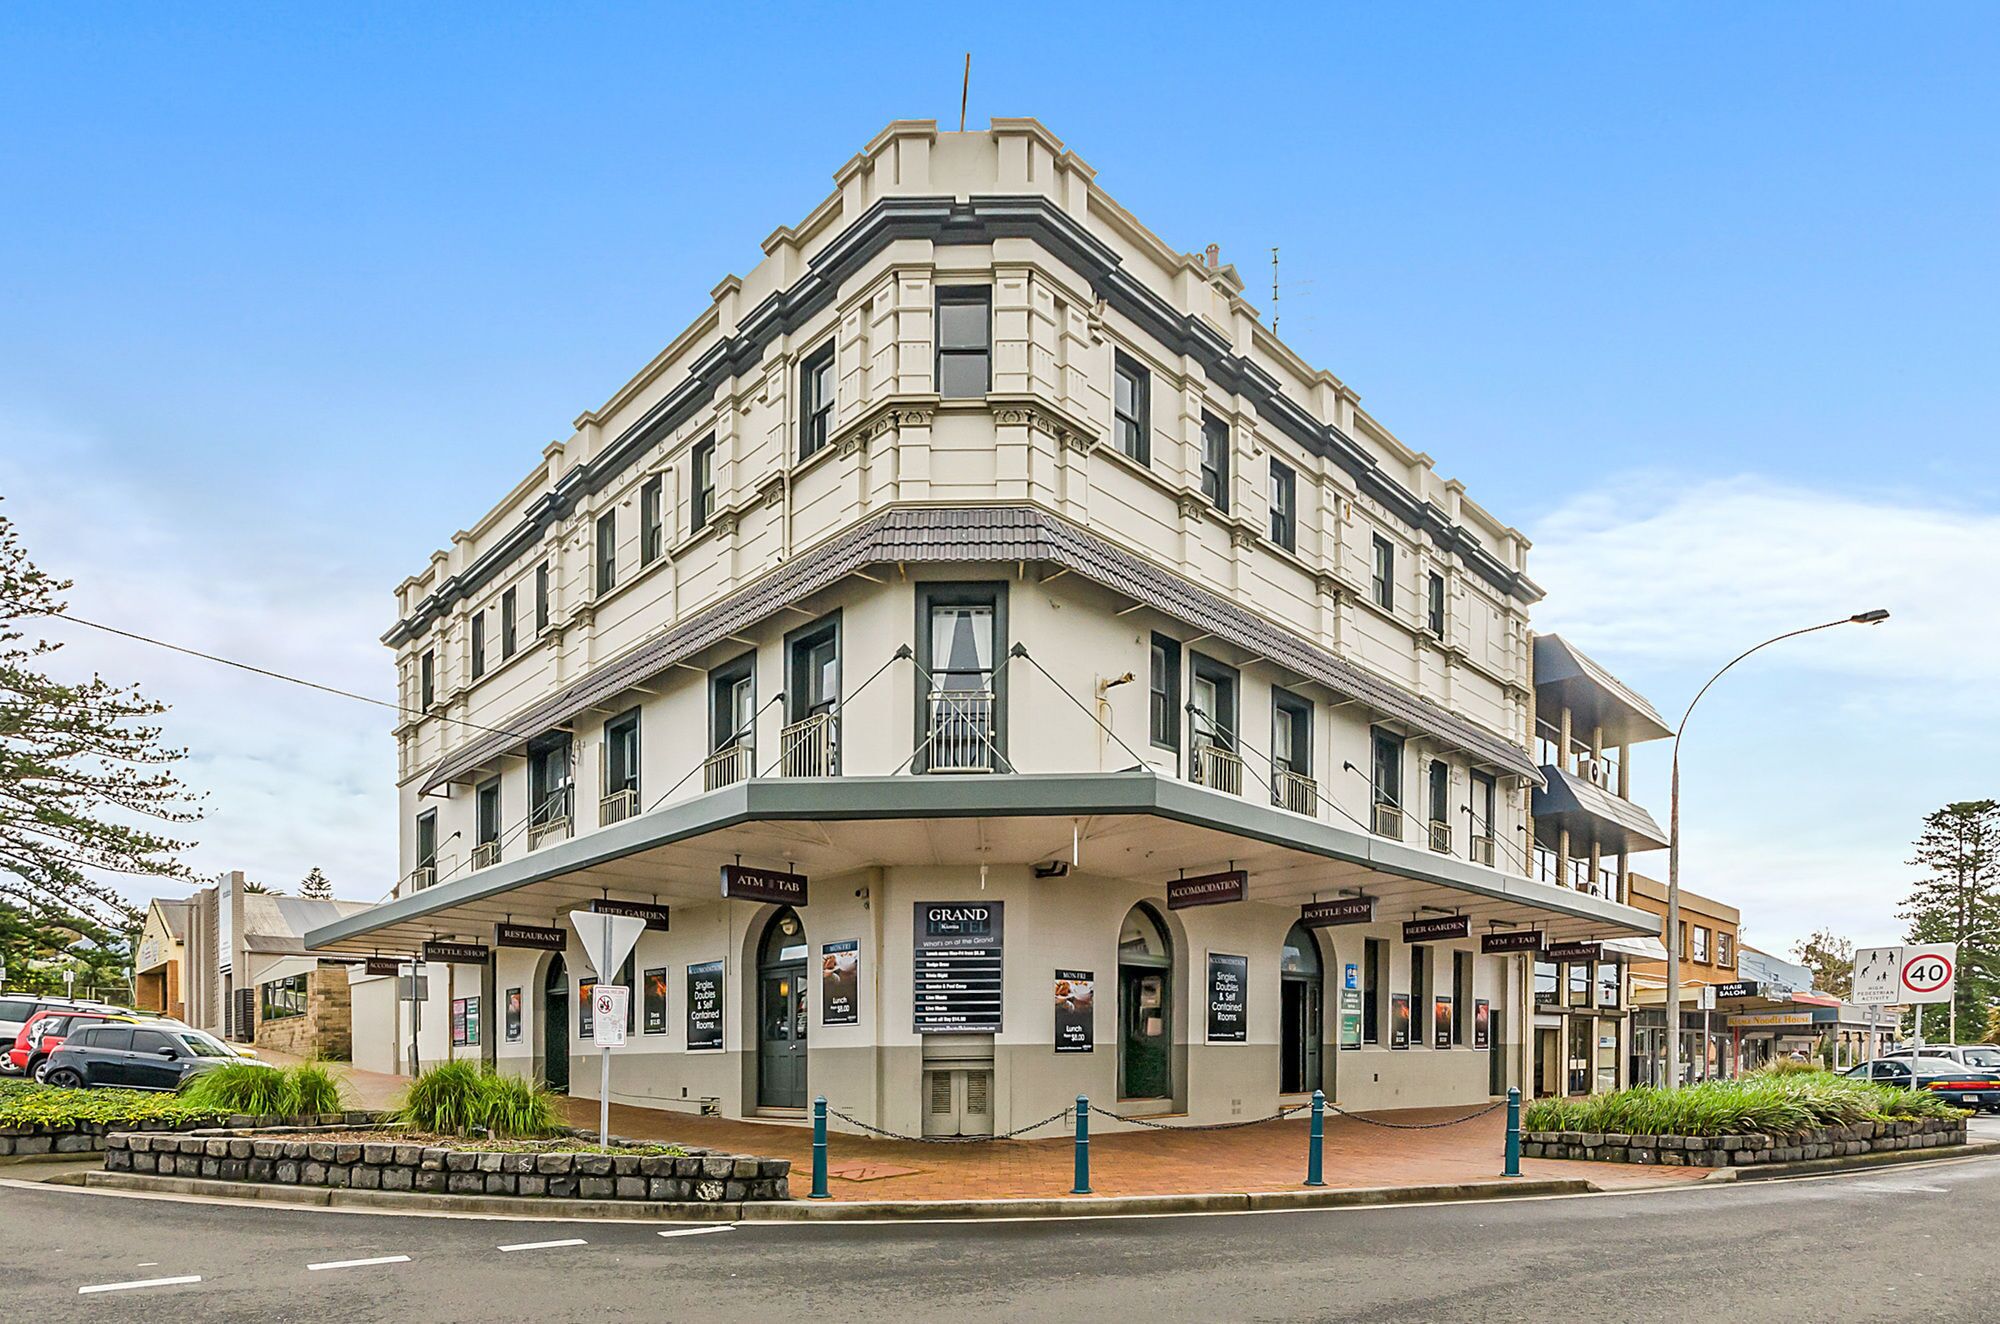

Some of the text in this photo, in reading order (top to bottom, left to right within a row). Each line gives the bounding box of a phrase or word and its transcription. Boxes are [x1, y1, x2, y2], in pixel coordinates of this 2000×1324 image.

[737, 875, 800, 892] ATM TAB
[1170, 880, 1240, 897] ACCOMMODATION
[625, 909, 666, 920] GARDEN
[928, 908, 989, 921] GRAND
[1304, 904, 1370, 919] BOTTLE SHOP
[1406, 921, 1465, 934] BEER GARDEN
[504, 930, 560, 942] RESTAURANT
[1488, 936, 1536, 946] ATM TAB
[427, 947, 461, 956] BOTTLE
[1550, 947, 1596, 957] RESTAURANT
[1910, 964, 1944, 982] 40
[1216, 982, 1239, 991] Doubles
[694, 991, 716, 1000] Doubles
[1225, 992, 1236, 1001] Self
[697, 1000, 713, 1009] & Self
[1212, 1002, 1242, 1011] Contained
[691, 1010, 720, 1020] Contained
[1217, 1012, 1236, 1021] Rooms
[696, 1021, 714, 1029] Rooms
